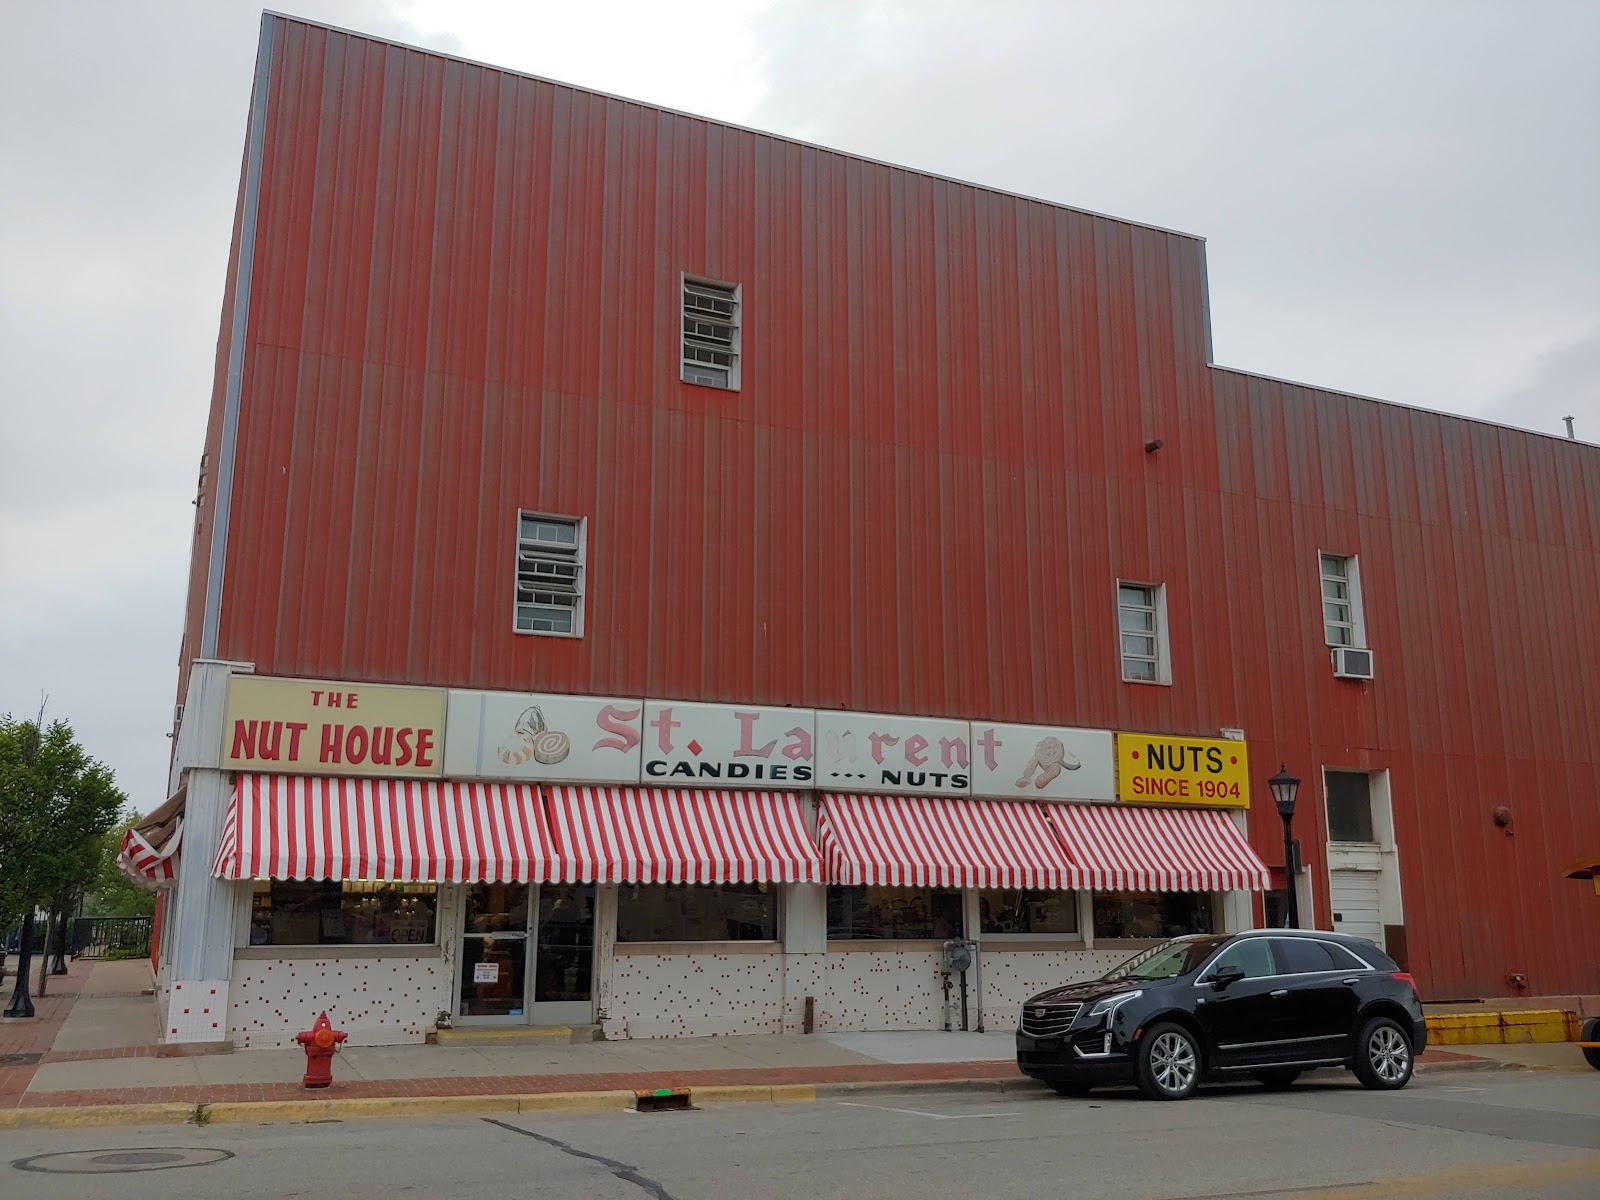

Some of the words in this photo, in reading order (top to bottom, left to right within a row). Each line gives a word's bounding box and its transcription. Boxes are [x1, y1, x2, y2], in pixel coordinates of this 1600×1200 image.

[310, 690, 359, 709] THE
[230, 719, 308, 763] NUT
[319, 723, 434, 767] HOUSE
[592, 703, 703, 756] St.
[733, 711, 1002, 771] Larent
[1147, 743, 1223, 773] NUTS
[645, 760, 812, 780] CANDIES
[882, 769, 968, 789] NUTS
[1132, 775, 1190, 797] SINCE
[1196, 779, 1241, 799] 1904
[392, 928, 425, 942] OPEN
